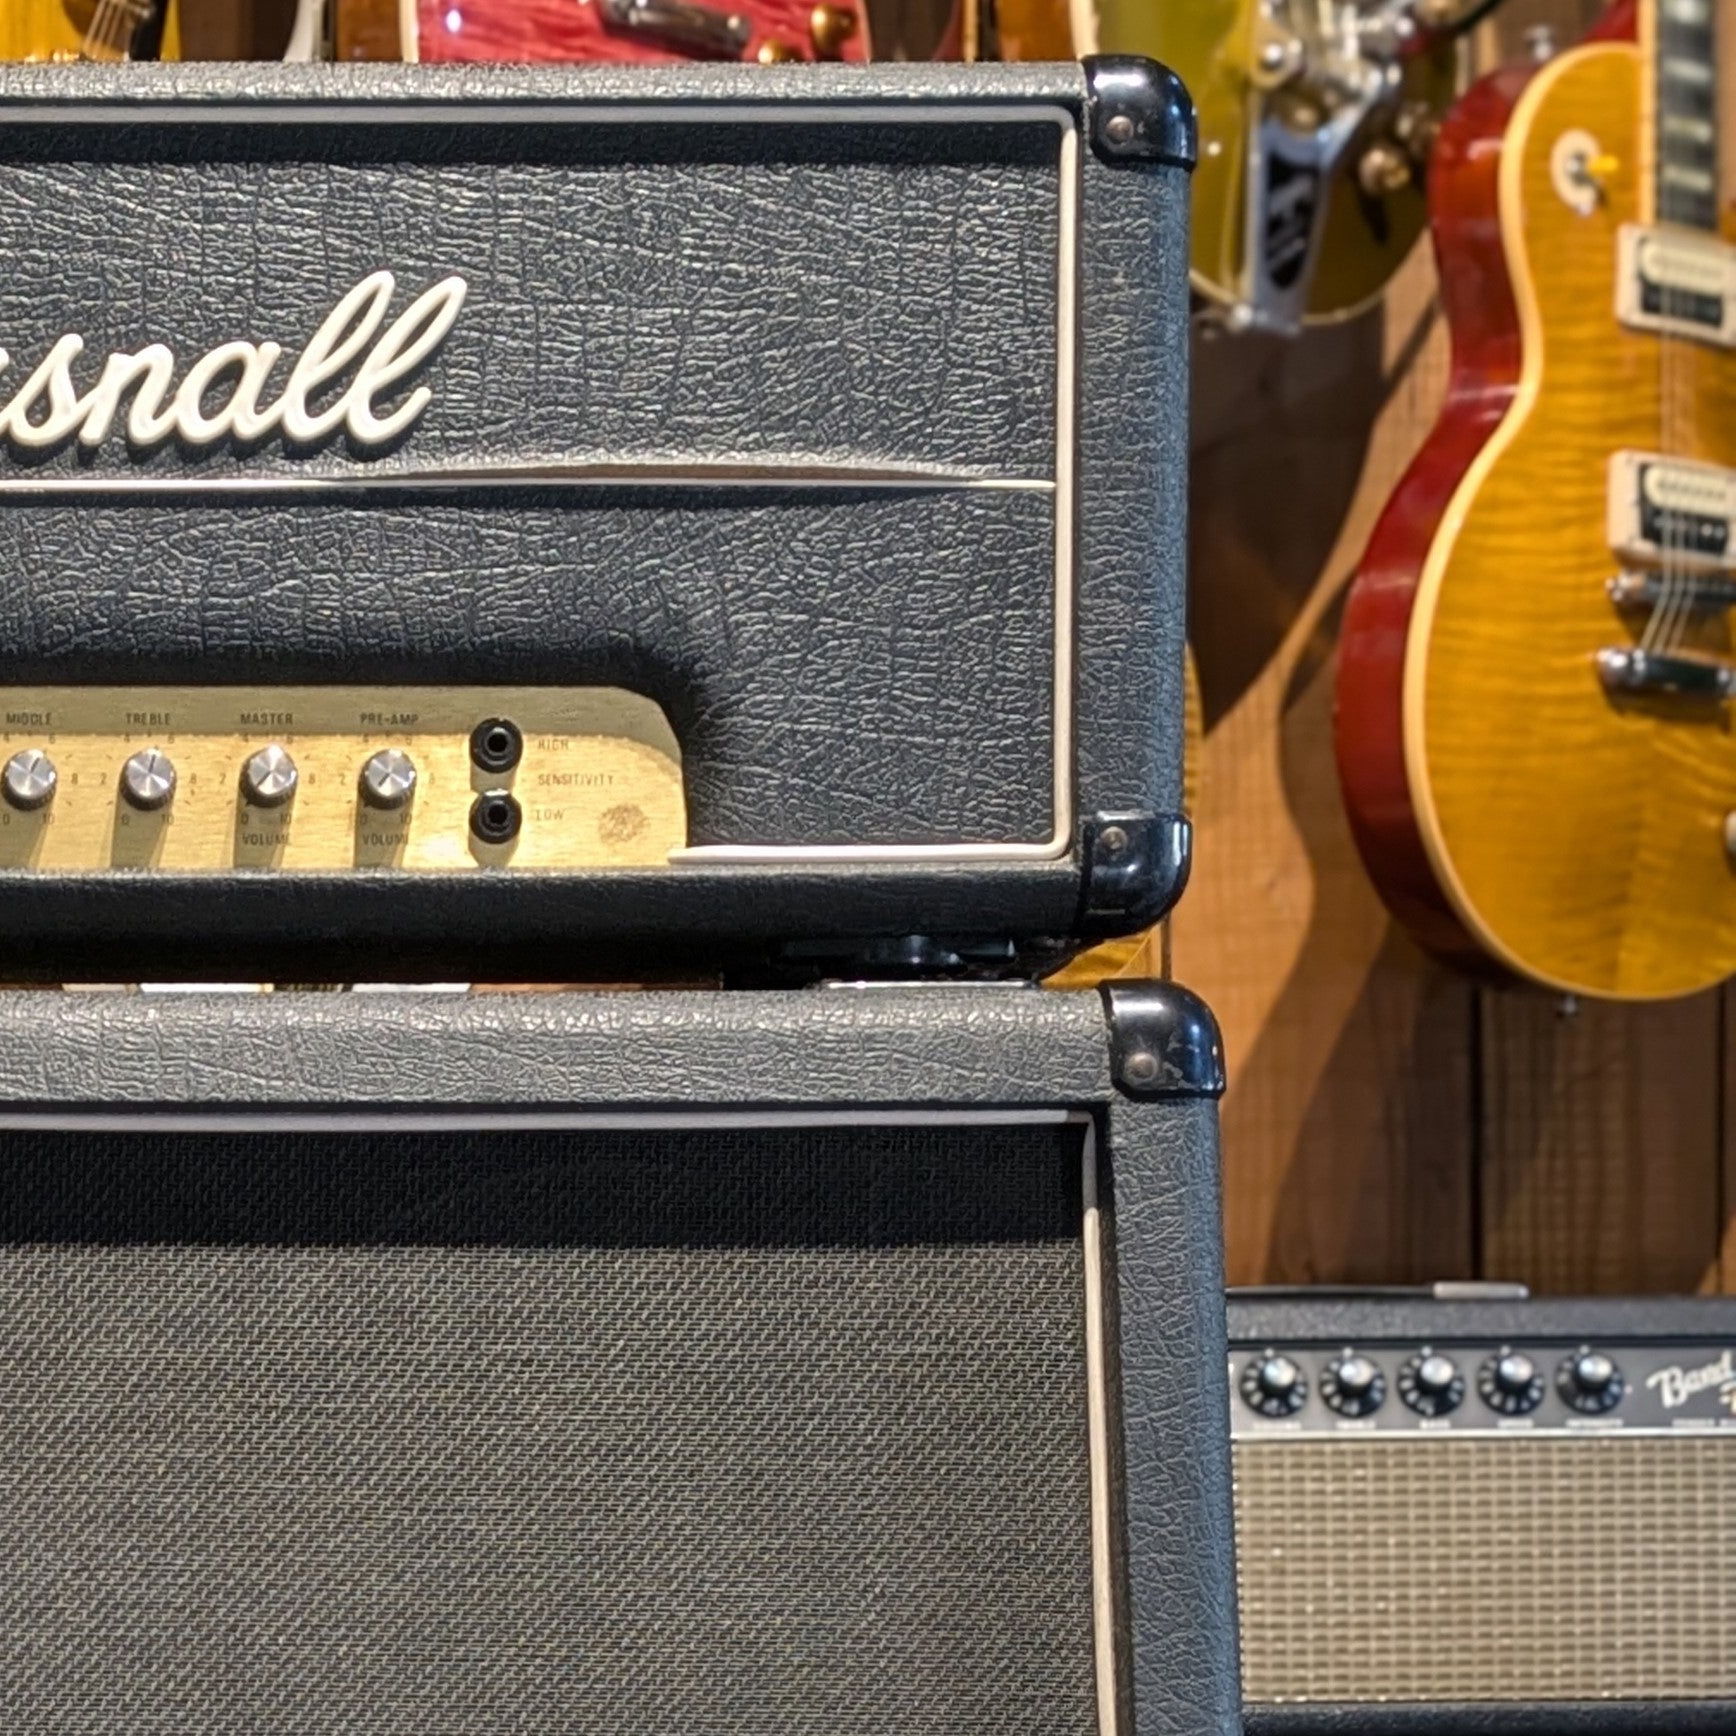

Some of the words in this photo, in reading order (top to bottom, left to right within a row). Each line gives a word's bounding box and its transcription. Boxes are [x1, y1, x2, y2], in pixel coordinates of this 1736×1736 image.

[6, 712, 52, 725] MIDDLE
[126, 712, 171, 725] TREBLE
[240, 712, 293, 725] MASTER
[360, 712, 419, 725] PRE-AMP
[538, 739, 569, 750] HIGH
[538, 773, 614, 786] SENSITIVITY
[535, 809, 564, 821] LOW
[242, 833, 290, 846] VOLUME
[363, 833, 409, 846] VOLUME
